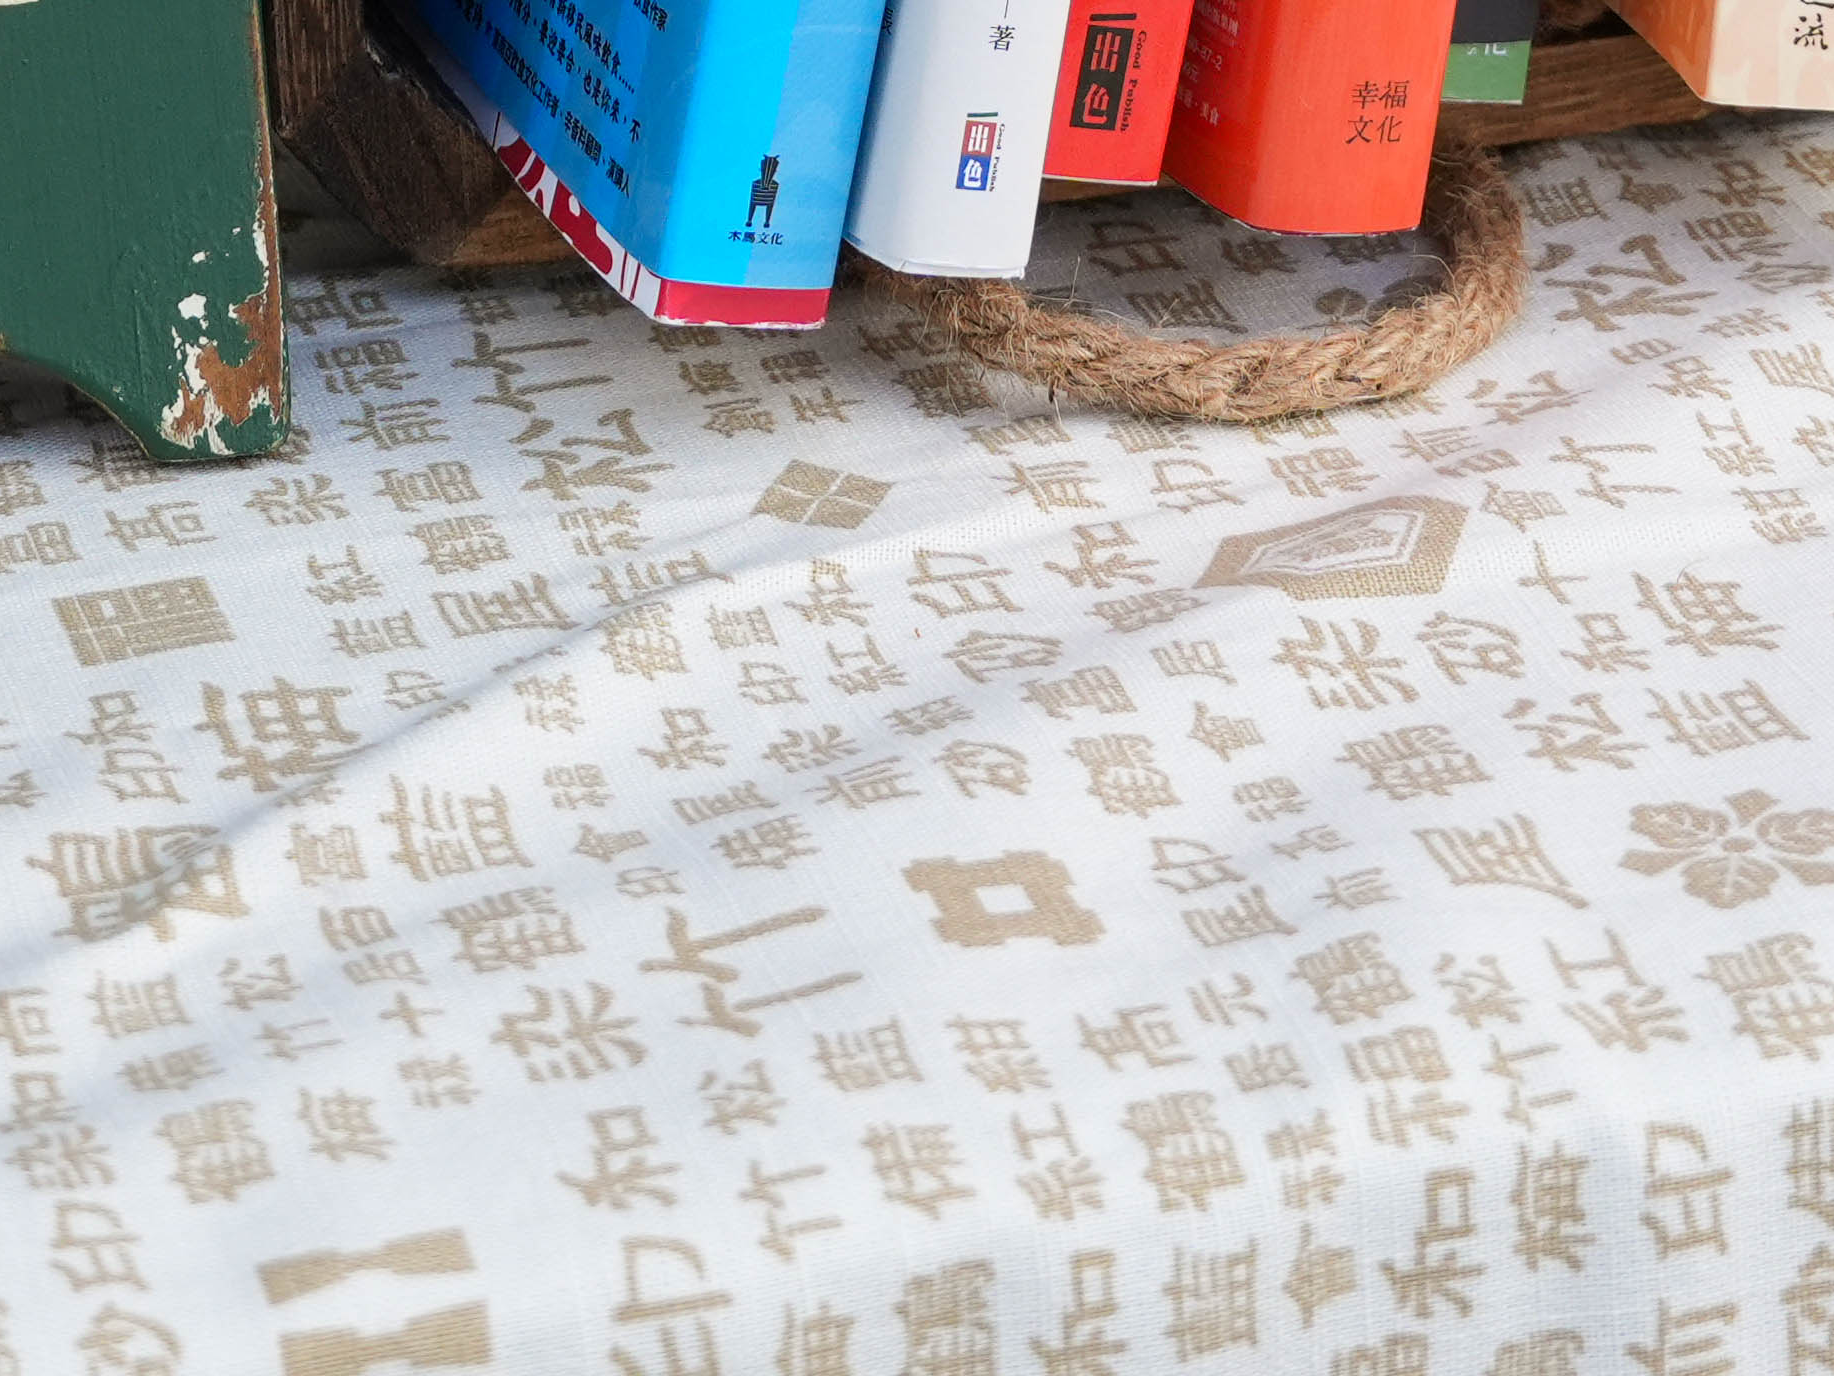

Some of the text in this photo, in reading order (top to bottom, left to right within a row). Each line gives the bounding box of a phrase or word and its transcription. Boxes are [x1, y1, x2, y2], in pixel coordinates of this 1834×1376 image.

[988, 24, 1016, 52] 著
[1131, 30, 1147, 70] Good
[1350, 79, 1411, 111] 幸福
[1345, 114, 1402, 146] 文化
[727, 230, 784, 246] 木馬文化
